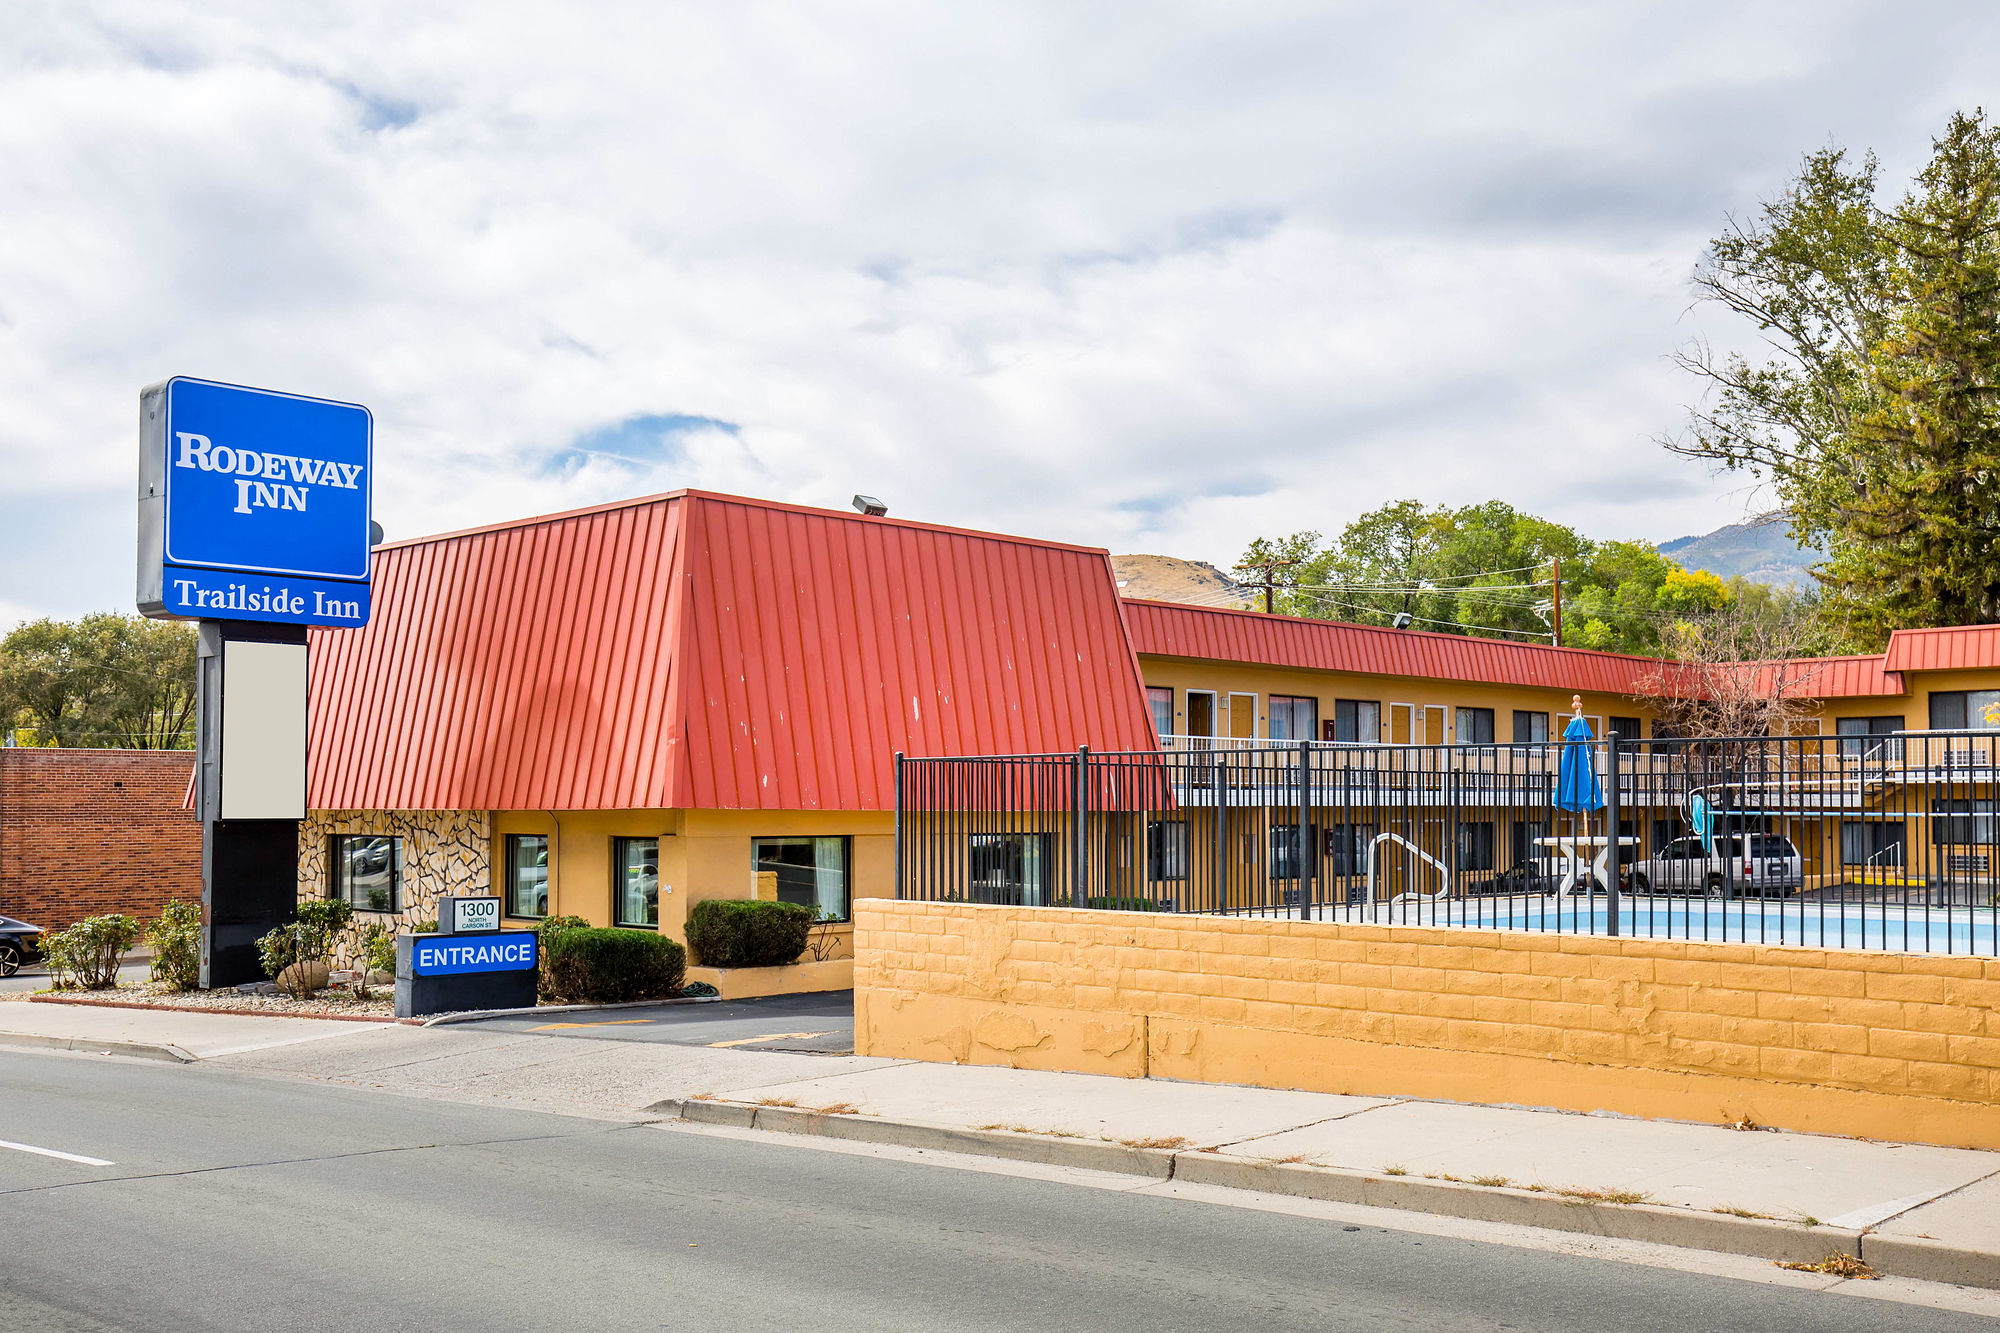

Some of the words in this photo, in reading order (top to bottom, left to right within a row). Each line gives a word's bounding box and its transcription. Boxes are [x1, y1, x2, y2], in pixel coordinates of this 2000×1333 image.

[175, 431, 363, 490] RODEWAY
[233, 478, 309, 515] INN
[173, 579, 305, 615] Trailside
[312, 590, 361, 619] Inn
[460, 902, 495, 917] 1300
[420, 944, 531, 967] ENTRANCE
